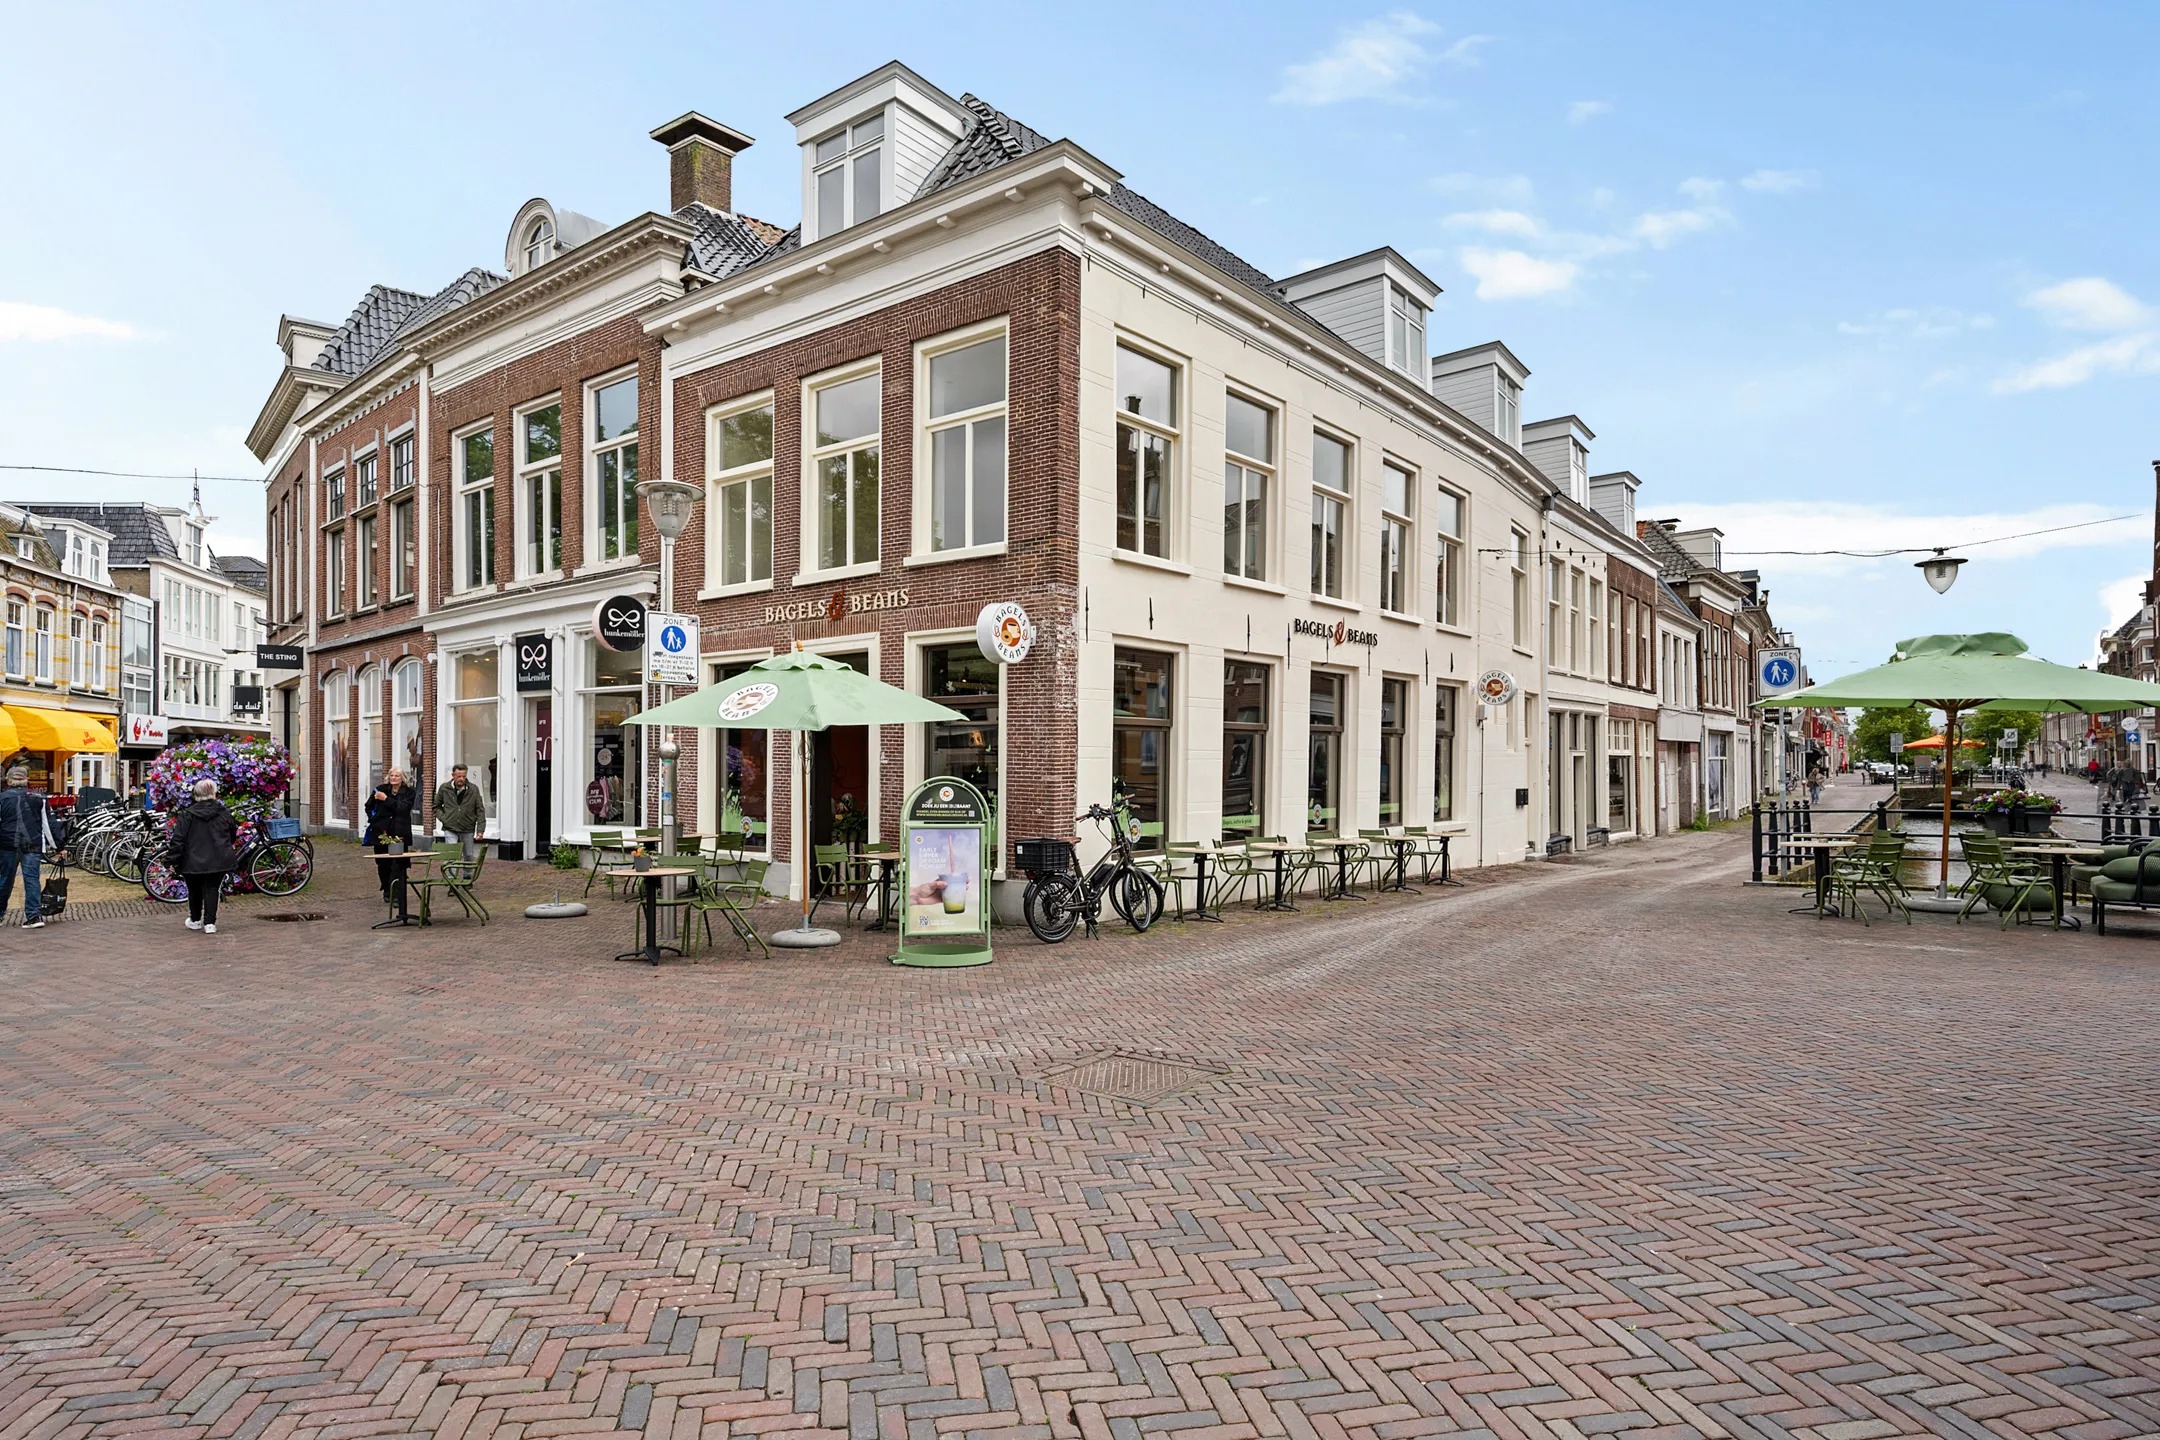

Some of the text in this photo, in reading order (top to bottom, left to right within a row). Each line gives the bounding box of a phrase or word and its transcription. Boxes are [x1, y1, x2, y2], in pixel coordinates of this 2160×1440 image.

[764, 585, 910, 623] BAGELS & BEANS
[663, 617, 685, 626] ZONE
[995, 605, 1026, 627] BAGELS
[604, 629, 646, 639] hunkemöller
[1293, 616, 1378, 647] BAGELS & BEANS
[997, 642, 1026, 659] BEANS
[275, 653, 298, 661] STING
[518, 672, 551, 683] hunkemöller
[1481, 672, 1509, 684] BAGELS
[1482, 693, 1507, 704] BEANS
[233, 701, 262, 710] de duif
